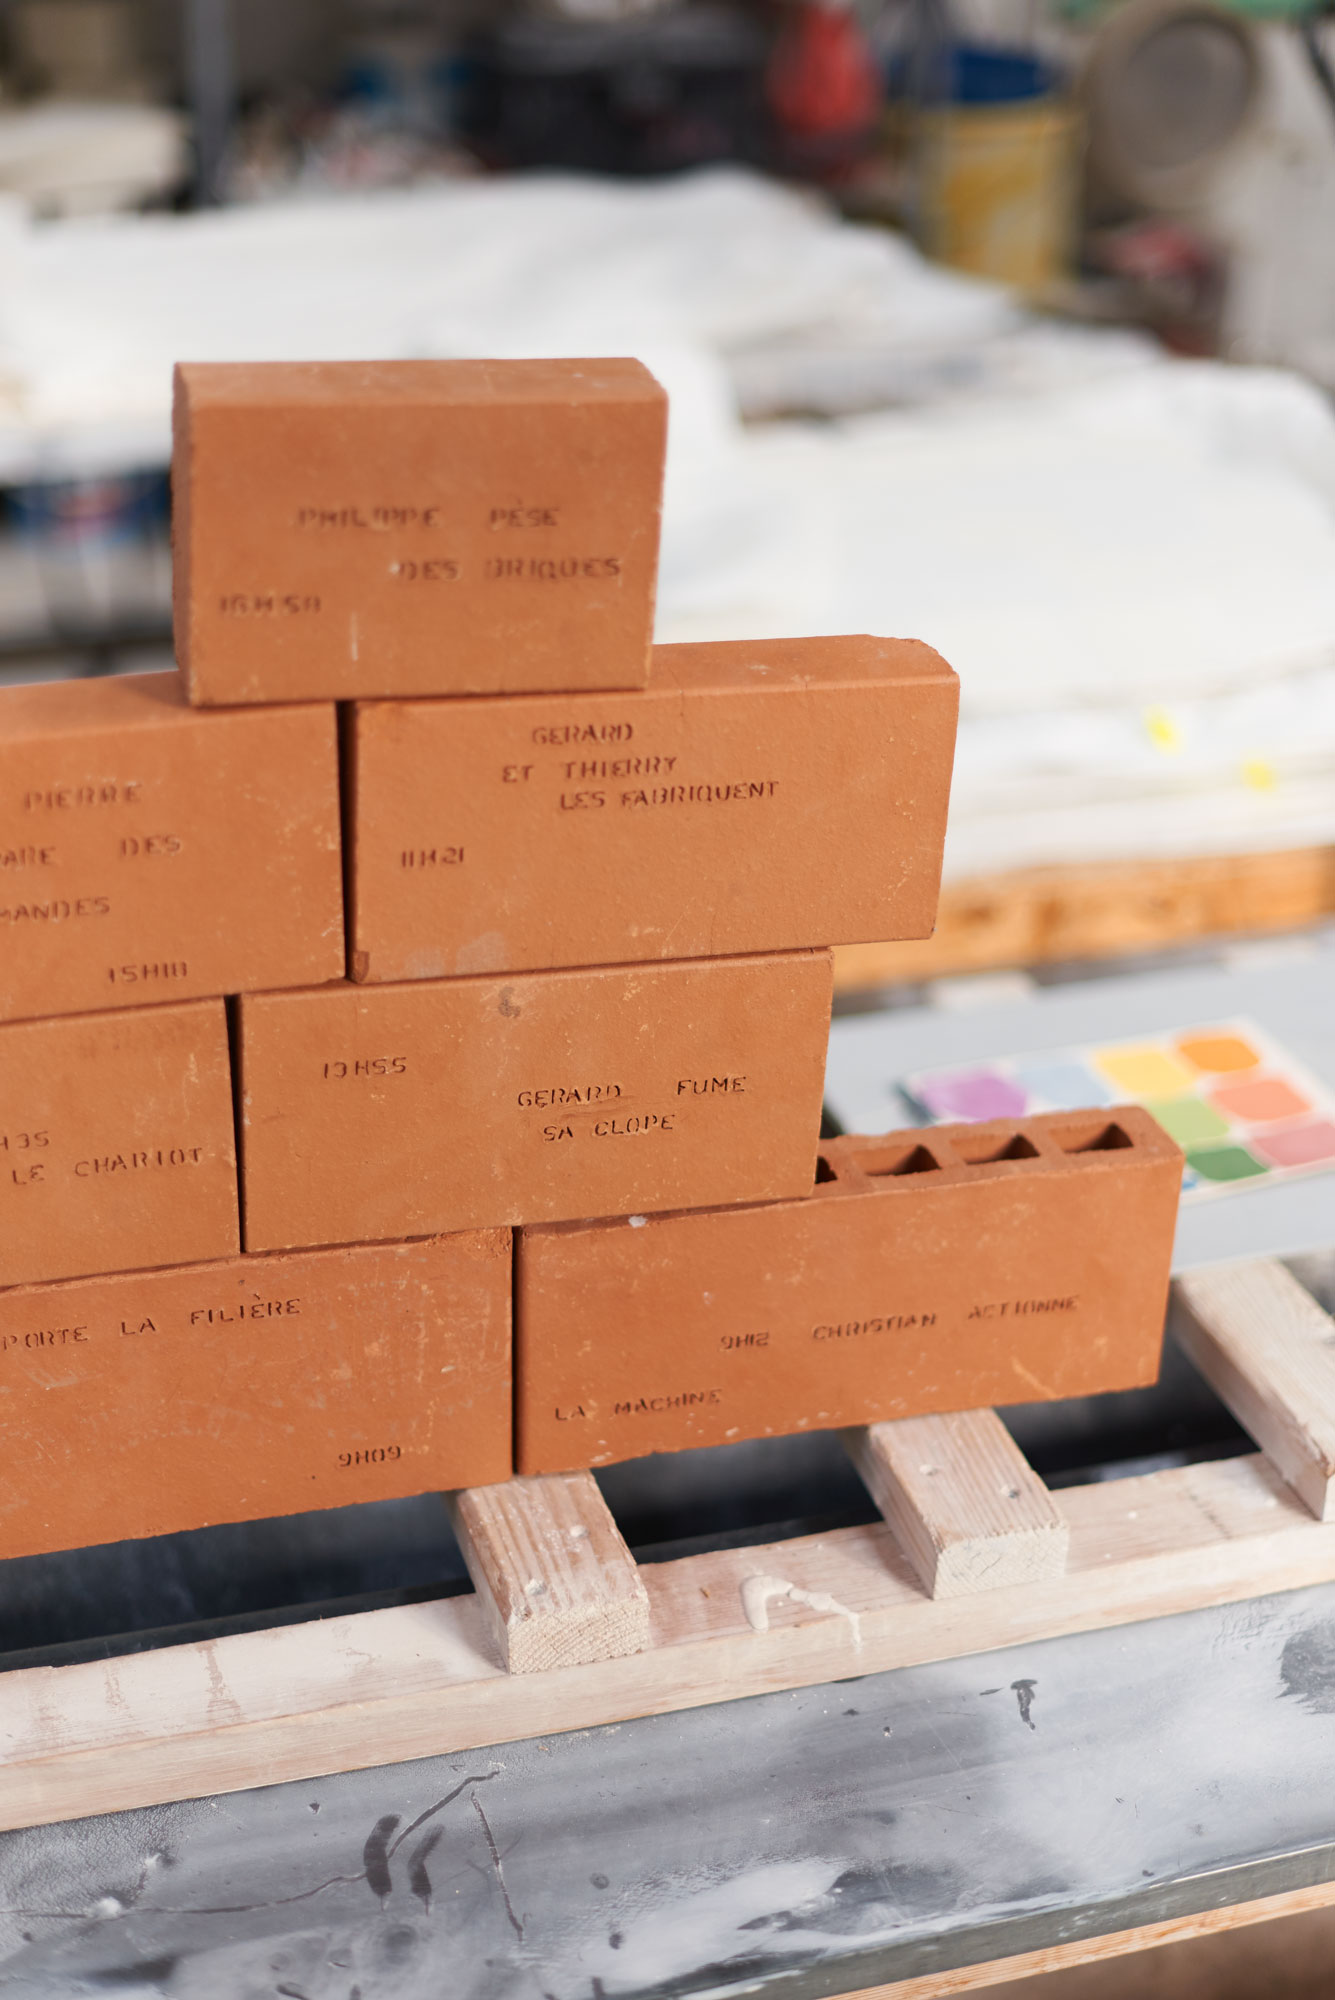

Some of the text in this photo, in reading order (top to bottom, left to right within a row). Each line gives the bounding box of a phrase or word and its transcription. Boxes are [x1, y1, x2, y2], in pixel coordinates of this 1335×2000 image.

[490, 499, 559, 528] PÈSE
[400, 556, 621, 580] DES BRIQUES
[533, 723, 633, 745] GERARD
[503, 756, 677, 783] ET THIERRY
[25, 783, 141, 809] PIERRE
[561, 780, 779, 811] LES FABRIQUENT
[120, 834, 181, 856] DES
[401, 846, 464, 868] 11H21
[323, 1056, 407, 1079] 13H55
[517, 1076, 746, 1107] GERARD FUME
[543, 1113, 675, 1142] SA CLOPE
[12, 1147, 202, 1185] LE CHARIOT
[3, 1293, 301, 1350] PORTE LA FILIÈRE
[720, 1295, 1080, 1349] 9H12 CHRISTIAN ACTIONNE
[555, 1388, 722, 1421] LA MACHINE
[338, 1445, 401, 1468] 9H09
